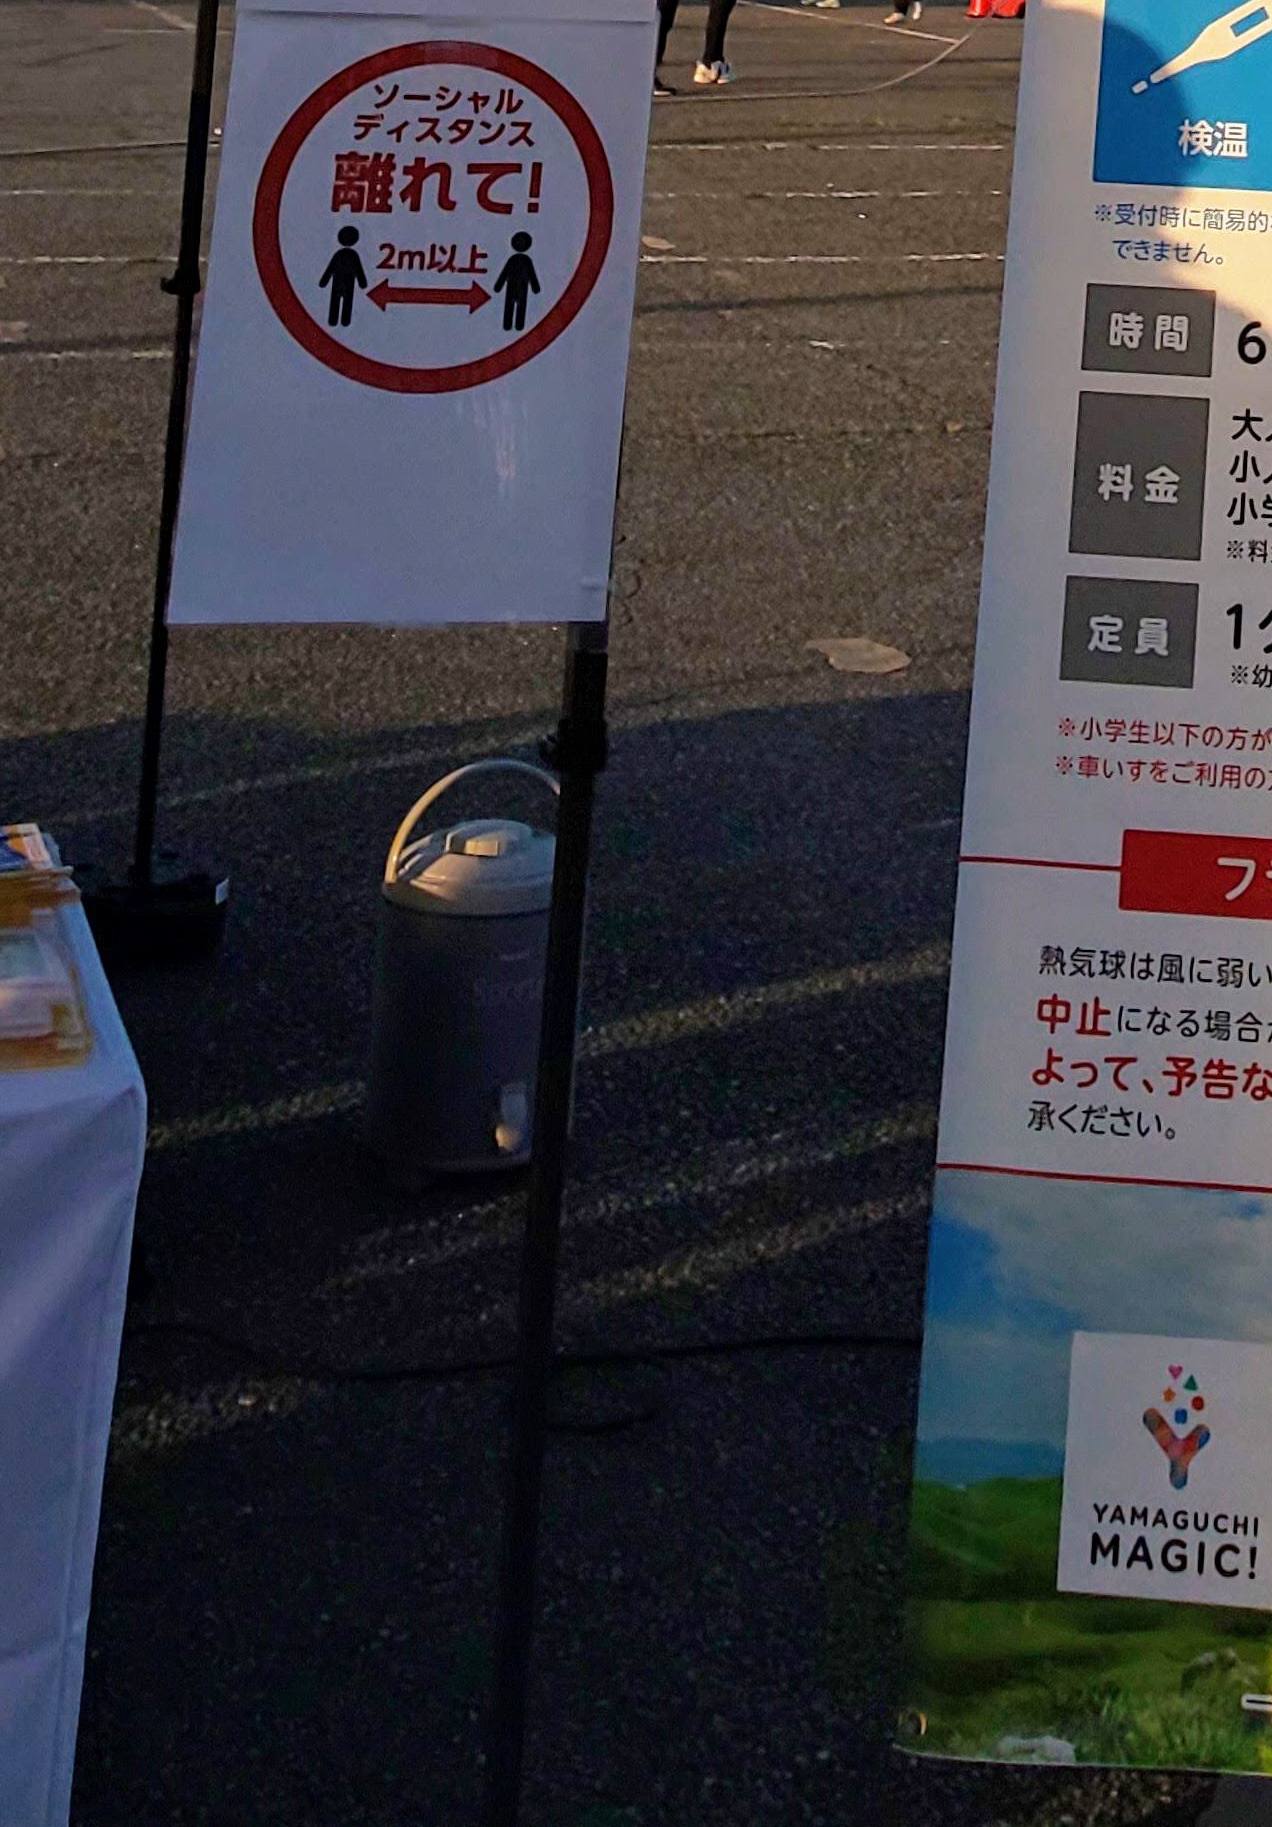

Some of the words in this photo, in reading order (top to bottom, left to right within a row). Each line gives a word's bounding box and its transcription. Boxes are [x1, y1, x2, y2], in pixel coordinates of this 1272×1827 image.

[374, 84, 523, 115] ソーシャル
[353, 113, 534, 147] ディスタンス
[1177, 119, 1249, 160] 検温
[331, 151, 543, 215] 離れて!
[376, 243, 488, 274] 2m以上
[1112, 238, 1225, 267] できません。
[1109, 311, 1189, 353] 時間
[1098, 462, 1181, 505] 料金
[1088, 613, 1172, 658] 定員
[1027, 1100, 1176, 1142] 承ください。
[1093, 1502, 1259, 1538] YAMAGUCHI
[1090, 1531, 1258, 1580] MAGIC!
